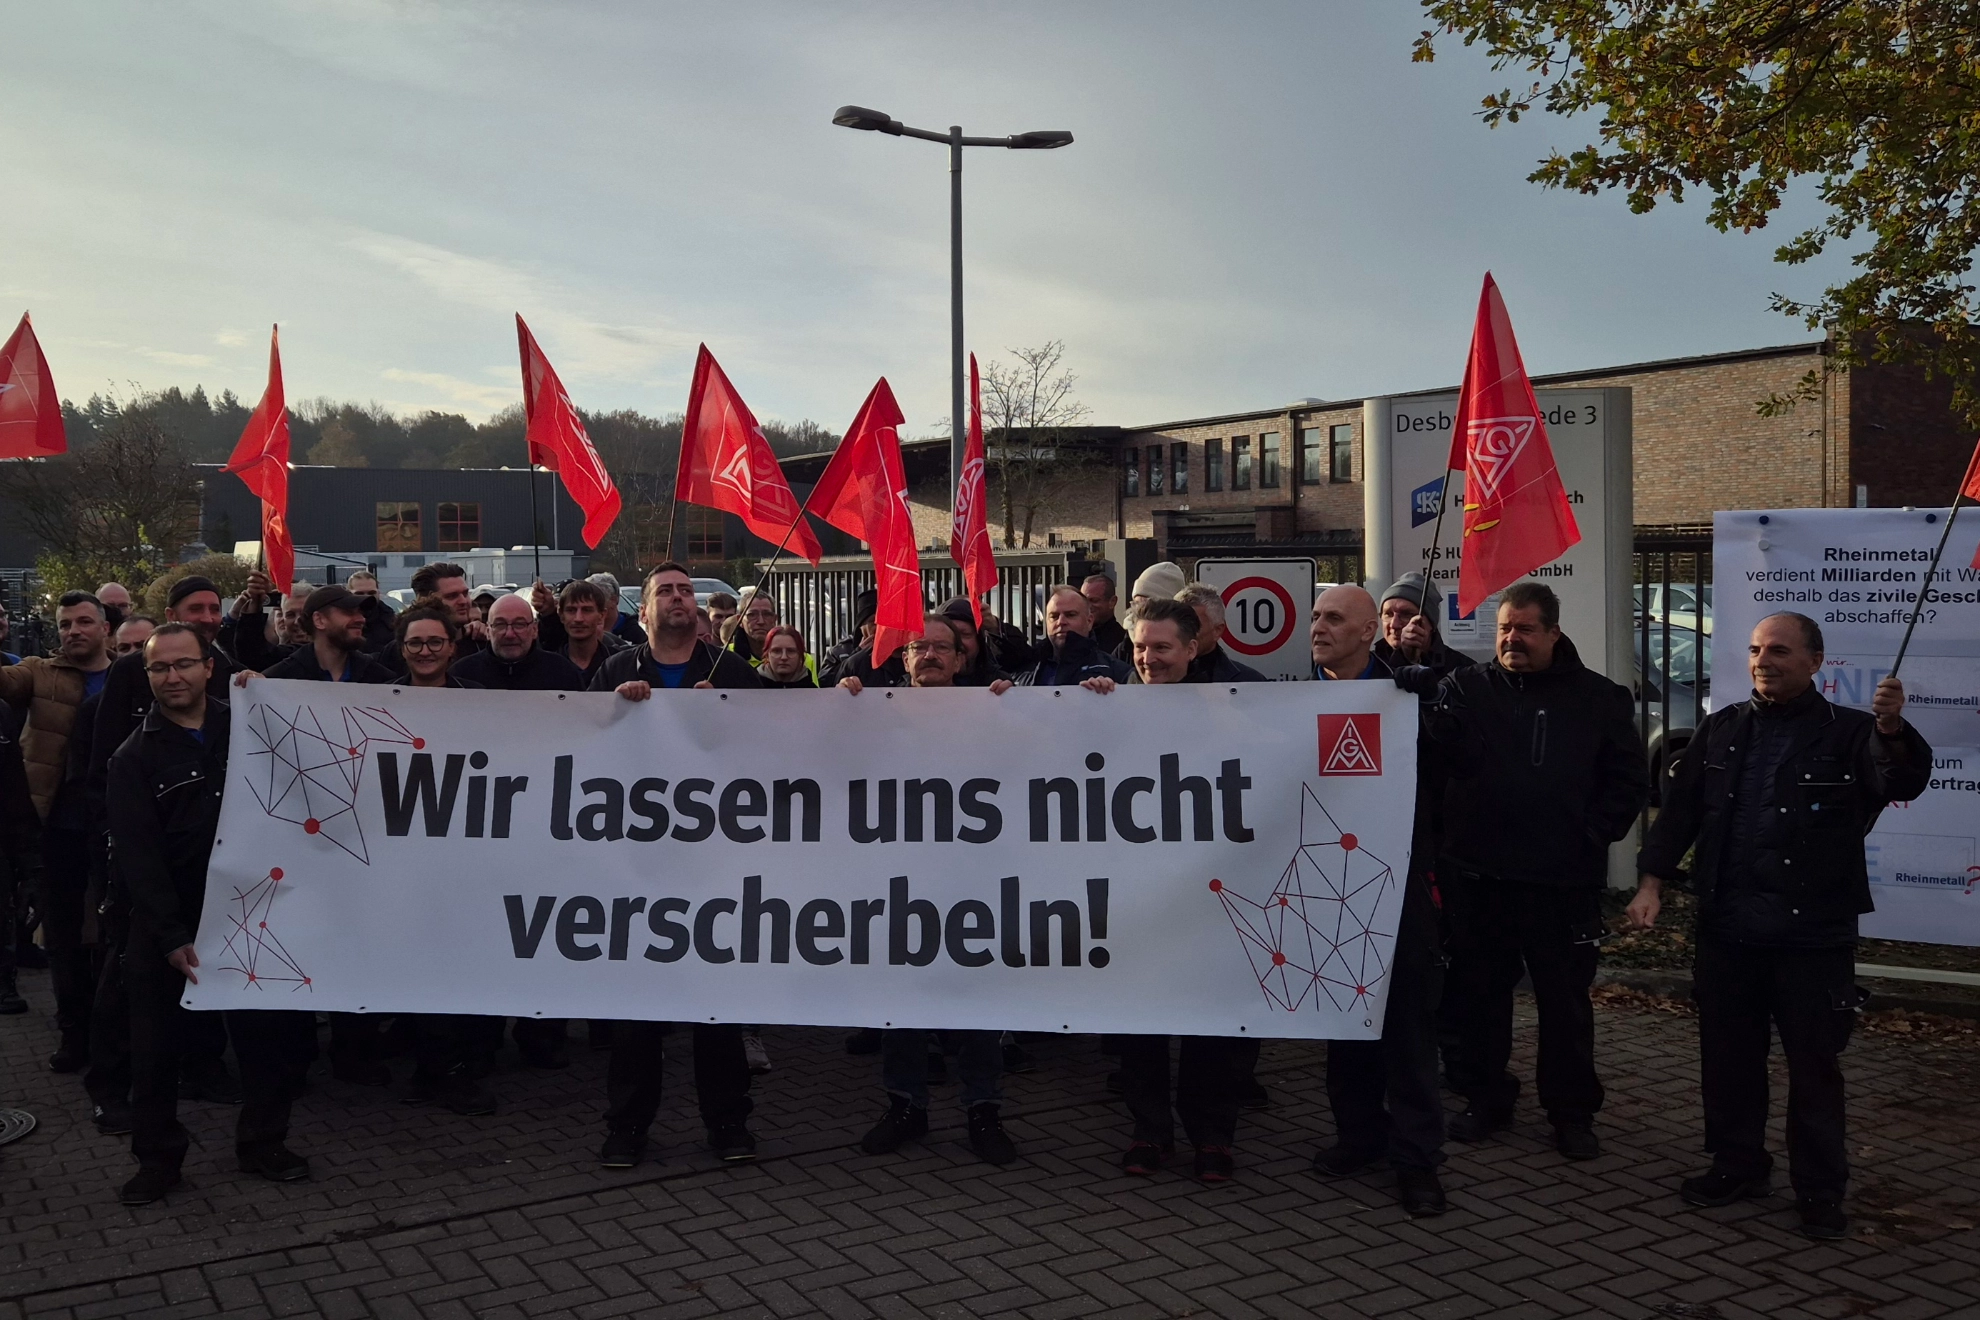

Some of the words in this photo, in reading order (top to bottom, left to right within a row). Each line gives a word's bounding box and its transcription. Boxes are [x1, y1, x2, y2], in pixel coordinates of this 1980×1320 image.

[1584, 405, 1597, 425] 3
[1824, 547, 1938, 562] Rheinmetal
[1746, 567, 1816, 582] verdient
[1821, 567, 1916, 582] Milliarden
[1923, 568, 1952, 582] mit
[1753, 588, 1823, 602] deshalb
[1828, 588, 1861, 603] das
[1866, 588, 1918, 603] zivile
[1236, 598, 1275, 634] 10
[1824, 608, 1937, 624] abschaffen?
[1908, 693, 1980, 707] Rheinmetall
[1931, 758, 1963, 770] um
[377, 751, 529, 838] Wir
[550, 755, 821, 843] lassen
[848, 778, 1003, 844] uns
[1028, 752, 1256, 844] nicht
[1895, 872, 1966, 887] Rheinmetall
[503, 875, 1111, 968] verscherbeln!
